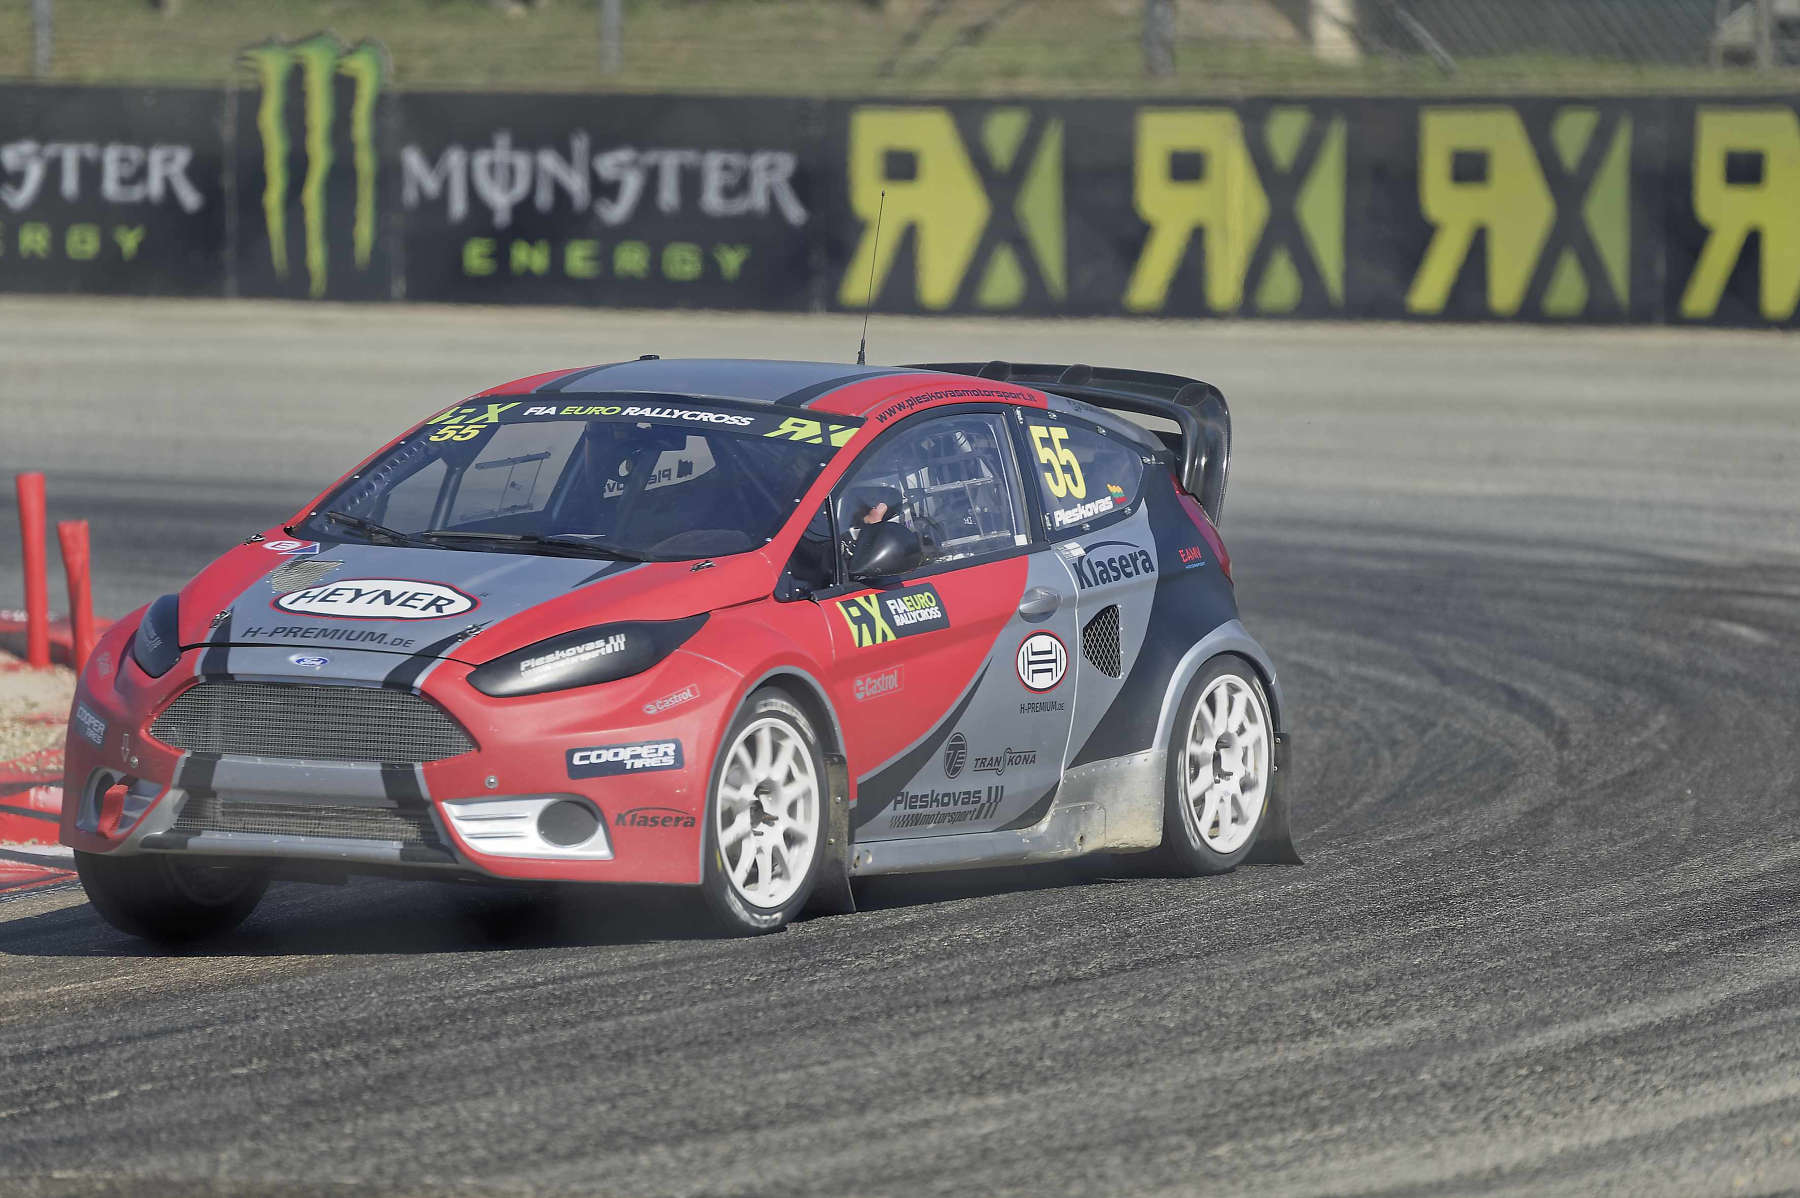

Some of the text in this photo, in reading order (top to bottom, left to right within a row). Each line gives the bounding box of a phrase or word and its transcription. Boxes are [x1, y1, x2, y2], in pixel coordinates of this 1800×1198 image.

[0, 138, 205, 213] STER
[401, 130, 808, 228] MONSTER
[1679, 107, 1800, 320] R
[0, 220, 146, 261] RGY
[462, 236, 751, 281] ENERGY
[523, 406, 756, 426] FIA EURO RALLYCROSS
[429, 425, 488, 442] 55
[1029, 425, 1086, 499] 55
[1053, 496, 1114, 528] Pleskovas
[1072, 549, 1155, 590] Klasera
[287, 587, 456, 614] HEYNER
[894, 606, 942, 627] RALLYCROSS
[241, 626, 416, 648] H-PREMIUM.DE
[520, 638, 606, 672] Pleskovas
[864, 669, 899, 697] Castrol
[655, 688, 692, 711] Castrol
[1020, 701, 1065, 714] H-PREMIUM.DE
[572, 742, 676, 766] COOPER
[623, 756, 675, 770] TIRES
[893, 786, 982, 811] Pleskovas
[614, 812, 696, 829] Klasera
[919, 809, 977, 827] motorsport
